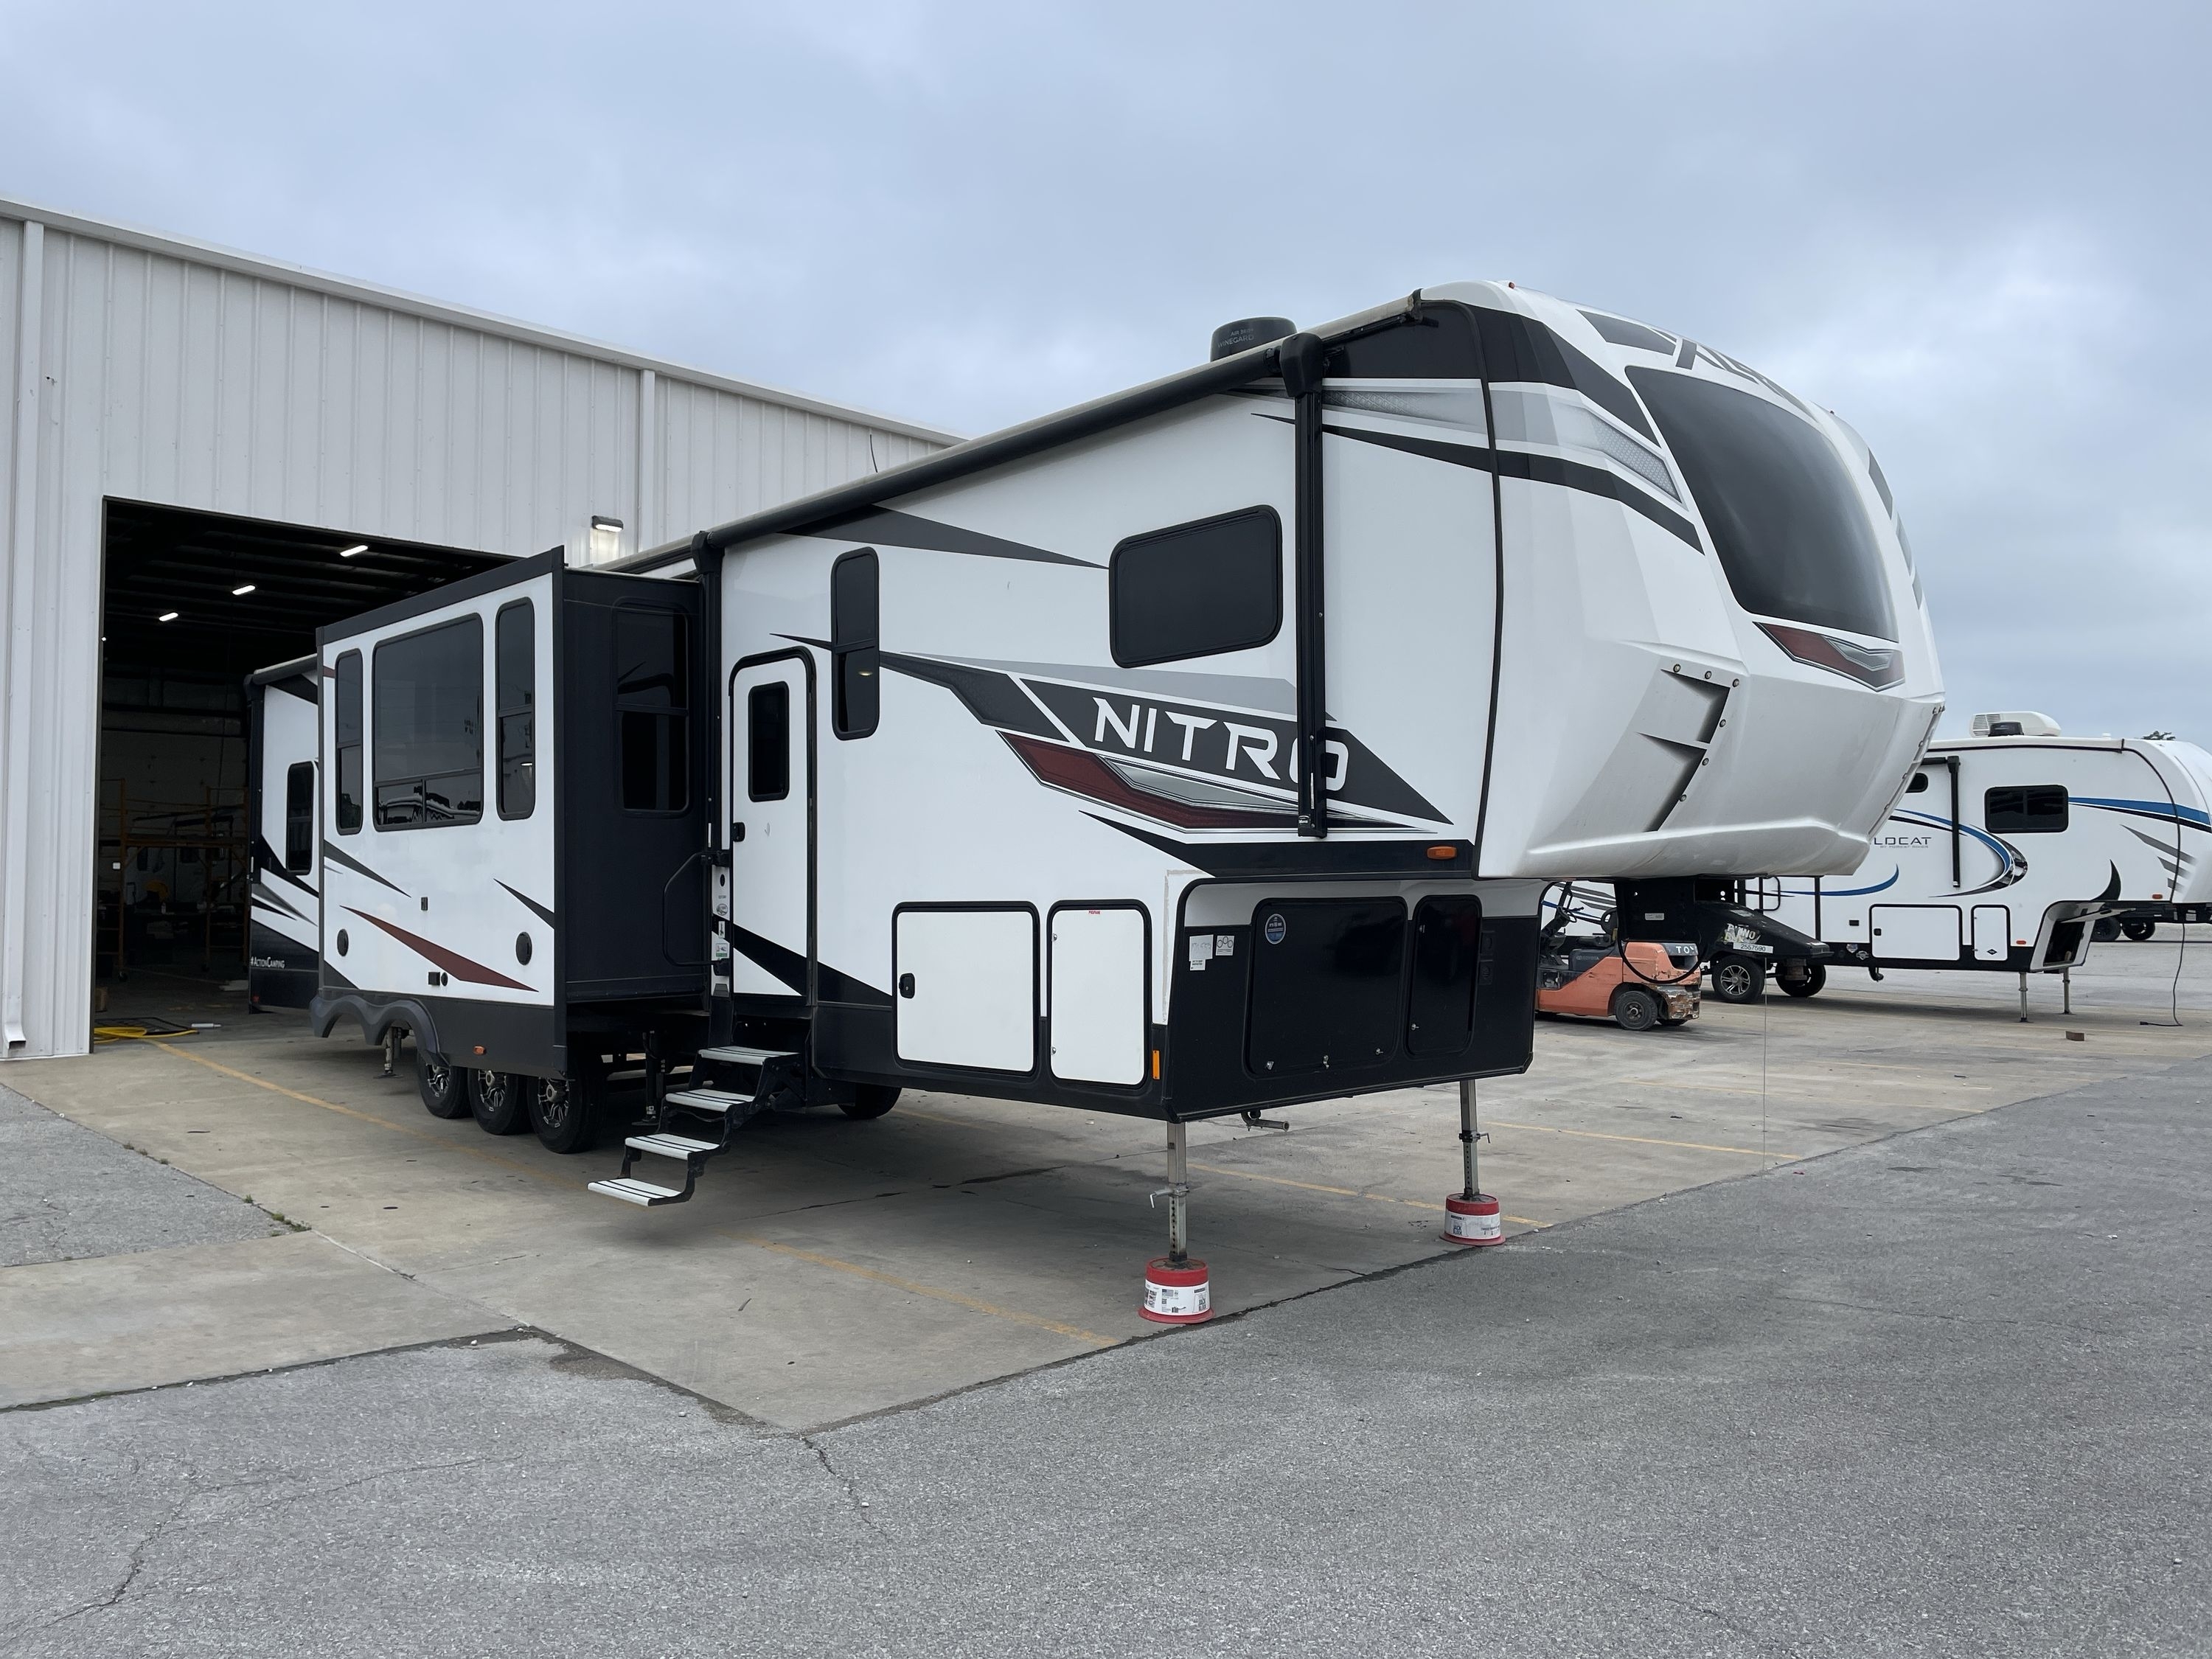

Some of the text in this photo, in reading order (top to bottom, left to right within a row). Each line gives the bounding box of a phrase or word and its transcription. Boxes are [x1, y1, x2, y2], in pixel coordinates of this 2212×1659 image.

[1217, 334, 1254, 348] WINEGARD
[1093, 697, 1349, 791] NITRO
[1874, 837, 1932, 845] LDCAT
